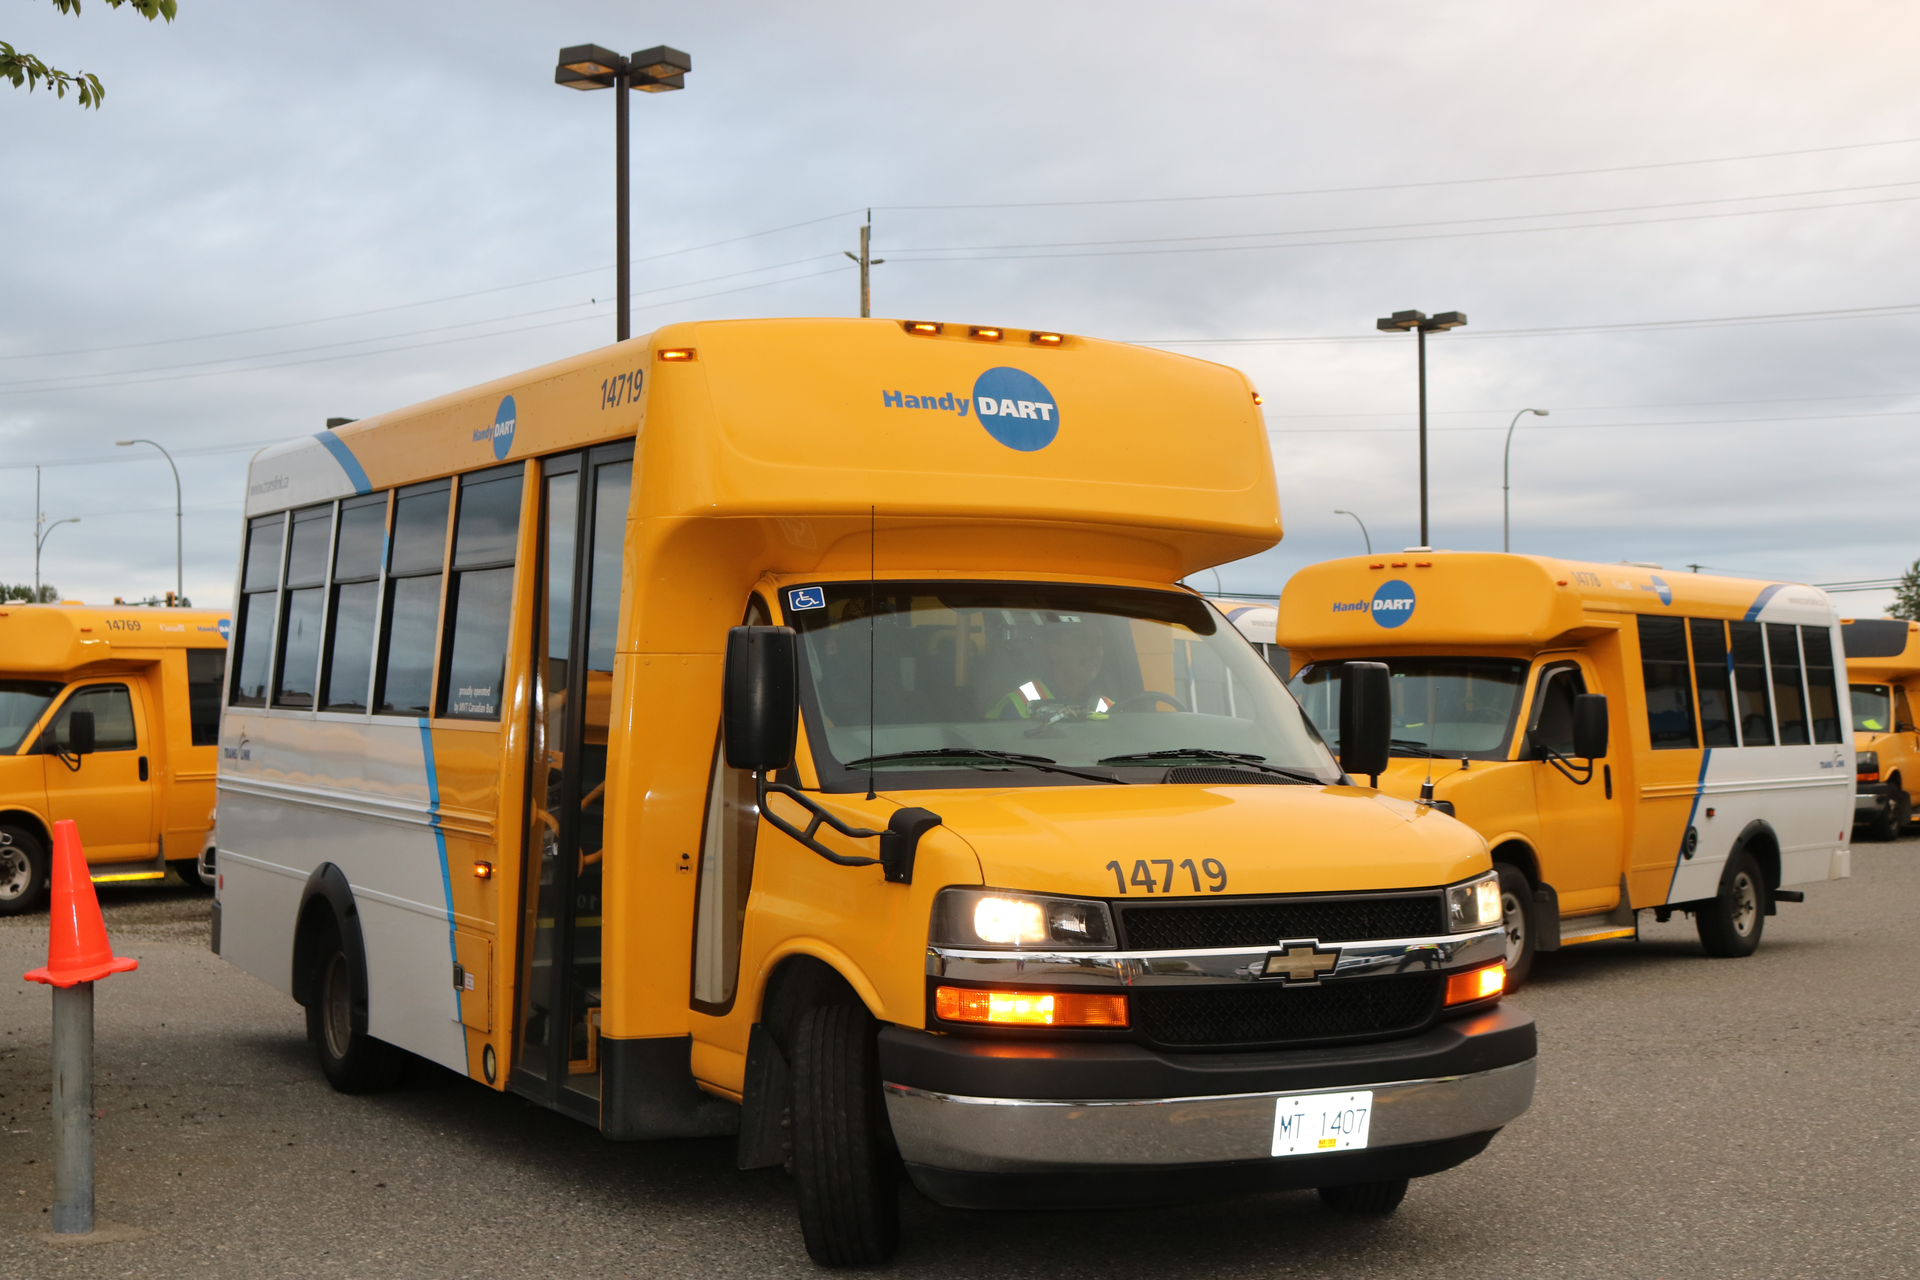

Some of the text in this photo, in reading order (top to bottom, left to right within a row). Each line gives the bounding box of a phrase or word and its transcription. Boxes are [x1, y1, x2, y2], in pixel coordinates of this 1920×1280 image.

[601, 368, 643, 411] 14719
[882, 389, 1053, 421] Handy DART
[472, 419, 515, 442] Handy DART
[1332, 598, 1414, 613] Handy DART
[105, 619, 142, 631] 14769
[197, 625, 231, 633] Handy DA
[459, 685, 491, 698] proudly operated
[468, 702, 486, 713] Canadian
[486, 703, 494, 714] Bus
[1105, 857, 1228, 895] 14719
[1279, 1108, 1367, 1141] MT 1407
